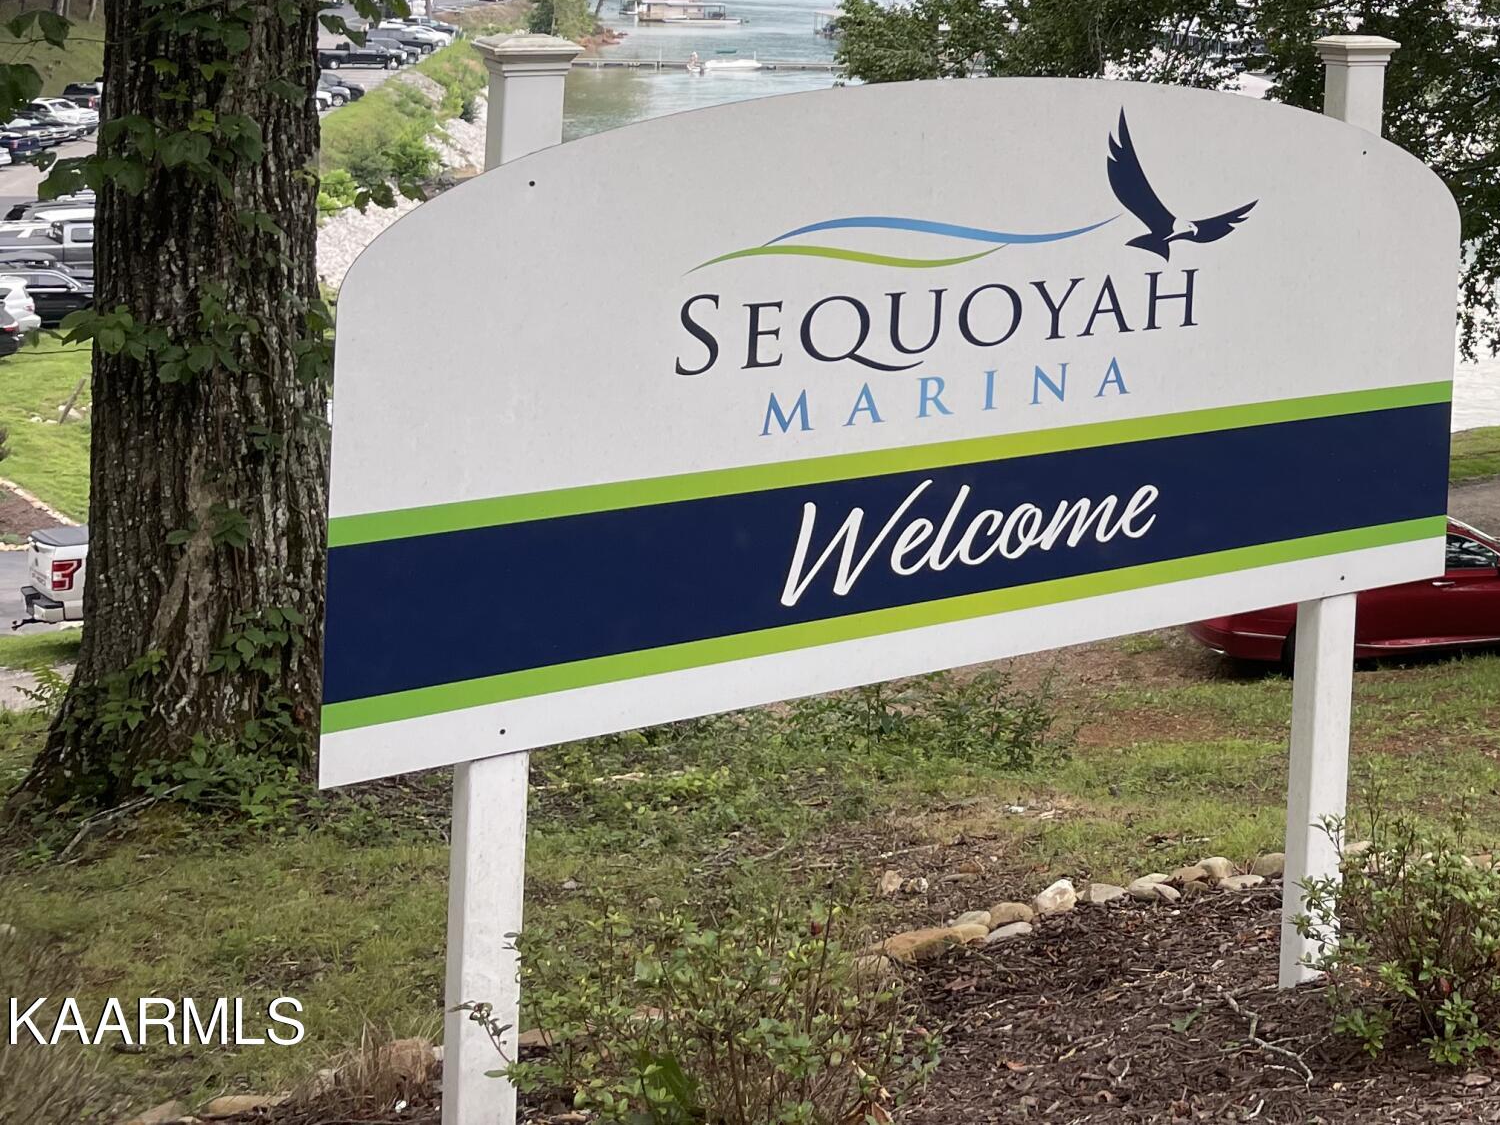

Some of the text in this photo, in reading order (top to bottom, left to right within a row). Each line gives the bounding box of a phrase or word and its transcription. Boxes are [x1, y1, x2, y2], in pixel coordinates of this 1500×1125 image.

[674, 268, 1199, 376] SEQUOYAH
[758, 356, 1131, 437] MARINA
[780, 479, 1159, 606] Welcome
